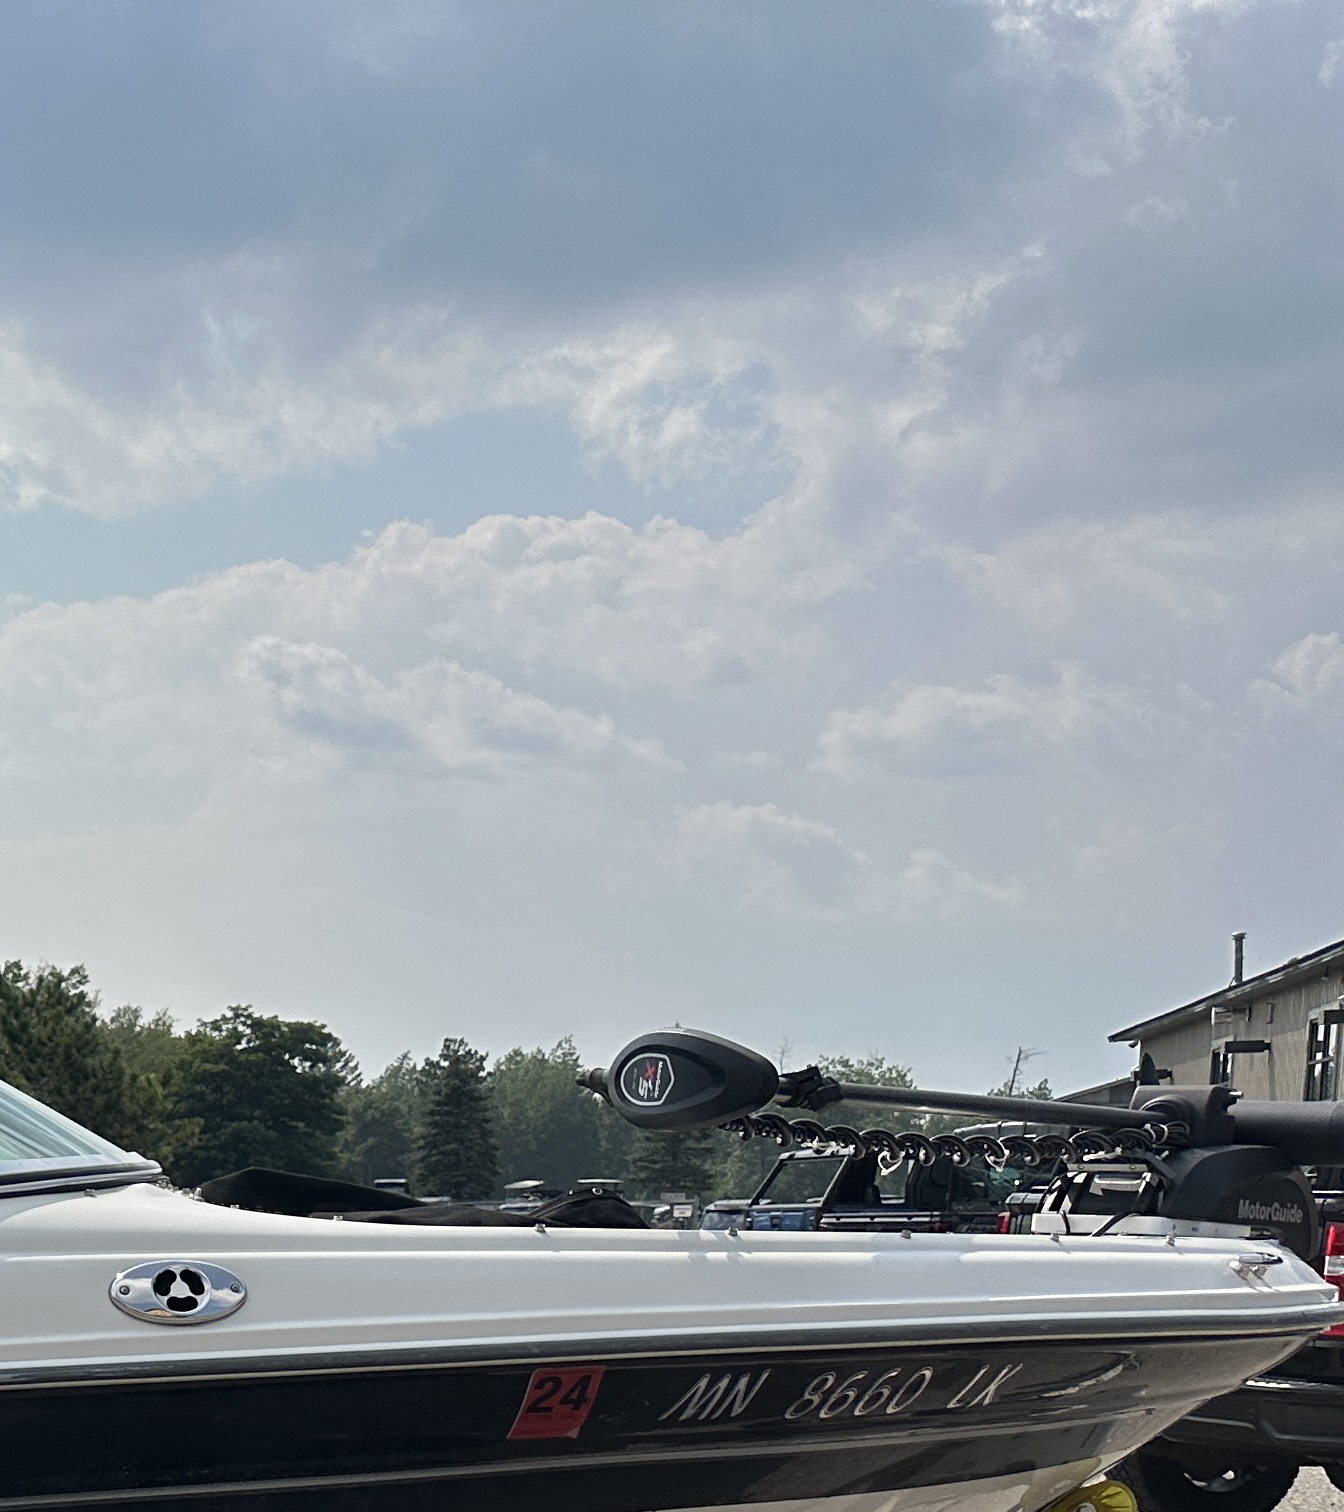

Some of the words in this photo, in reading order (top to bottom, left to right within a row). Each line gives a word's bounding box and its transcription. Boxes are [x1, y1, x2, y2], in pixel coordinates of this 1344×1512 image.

[1238, 1199, 1303, 1224] MotorGuide
[525, 1374, 593, 1414] 24
[657, 1369, 771, 1421] MN
[783, 1365, 934, 1420] 8660
[946, 1362, 1024, 1408] LK
